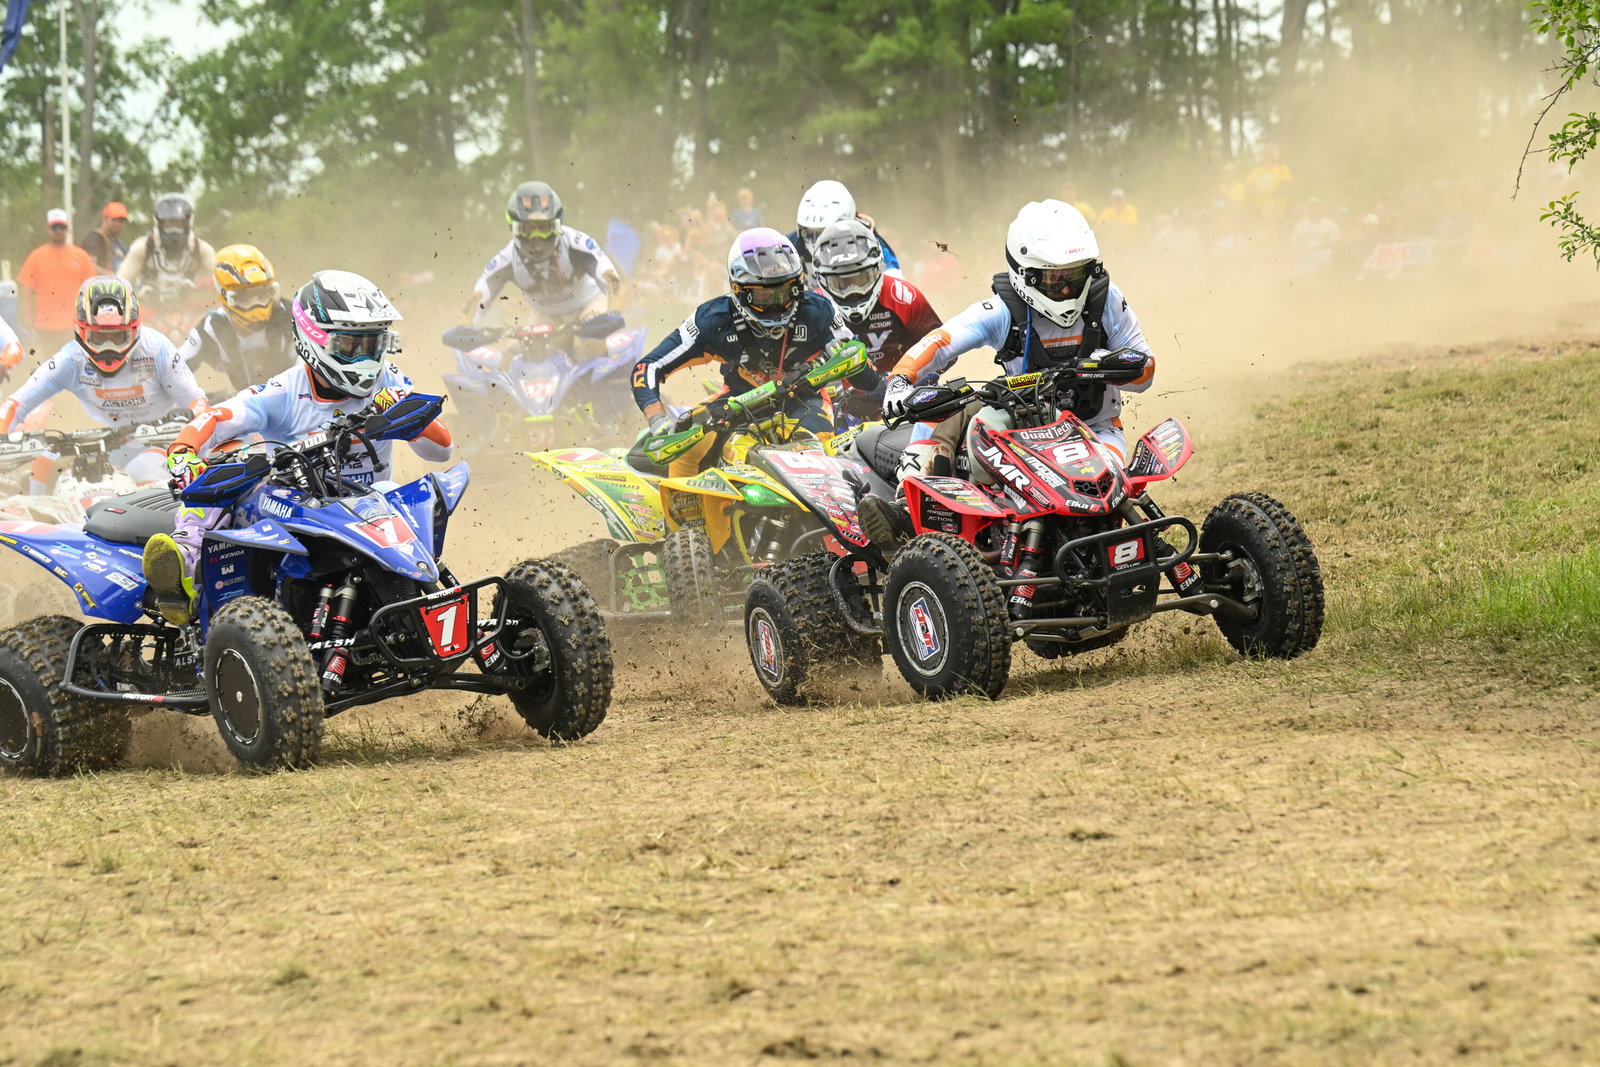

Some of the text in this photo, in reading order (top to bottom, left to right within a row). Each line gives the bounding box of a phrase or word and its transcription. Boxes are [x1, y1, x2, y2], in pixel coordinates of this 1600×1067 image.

[830, 252, 858, 265] FLY
[869, 321, 891, 329] ACTION
[1020, 422, 1073, 440] Quad Tech
[1052, 441, 1091, 465] 8
[977, 446, 1031, 492] JMR
[261, 496, 293, 519] YAMAHA
[1065, 499, 1090, 510] Elka
[1112, 492, 1125, 508] Elka
[927, 515, 953, 523] ACTION
[1149, 503, 1162, 518] Elka
[376, 520, 399, 544] 1
[220, 549, 245, 560] KENDA
[1114, 540, 1139, 565] 8
[1180, 573, 1199, 592] Elka
[1010, 595, 1033, 608] Elka
[436, 605, 458, 647] 1
